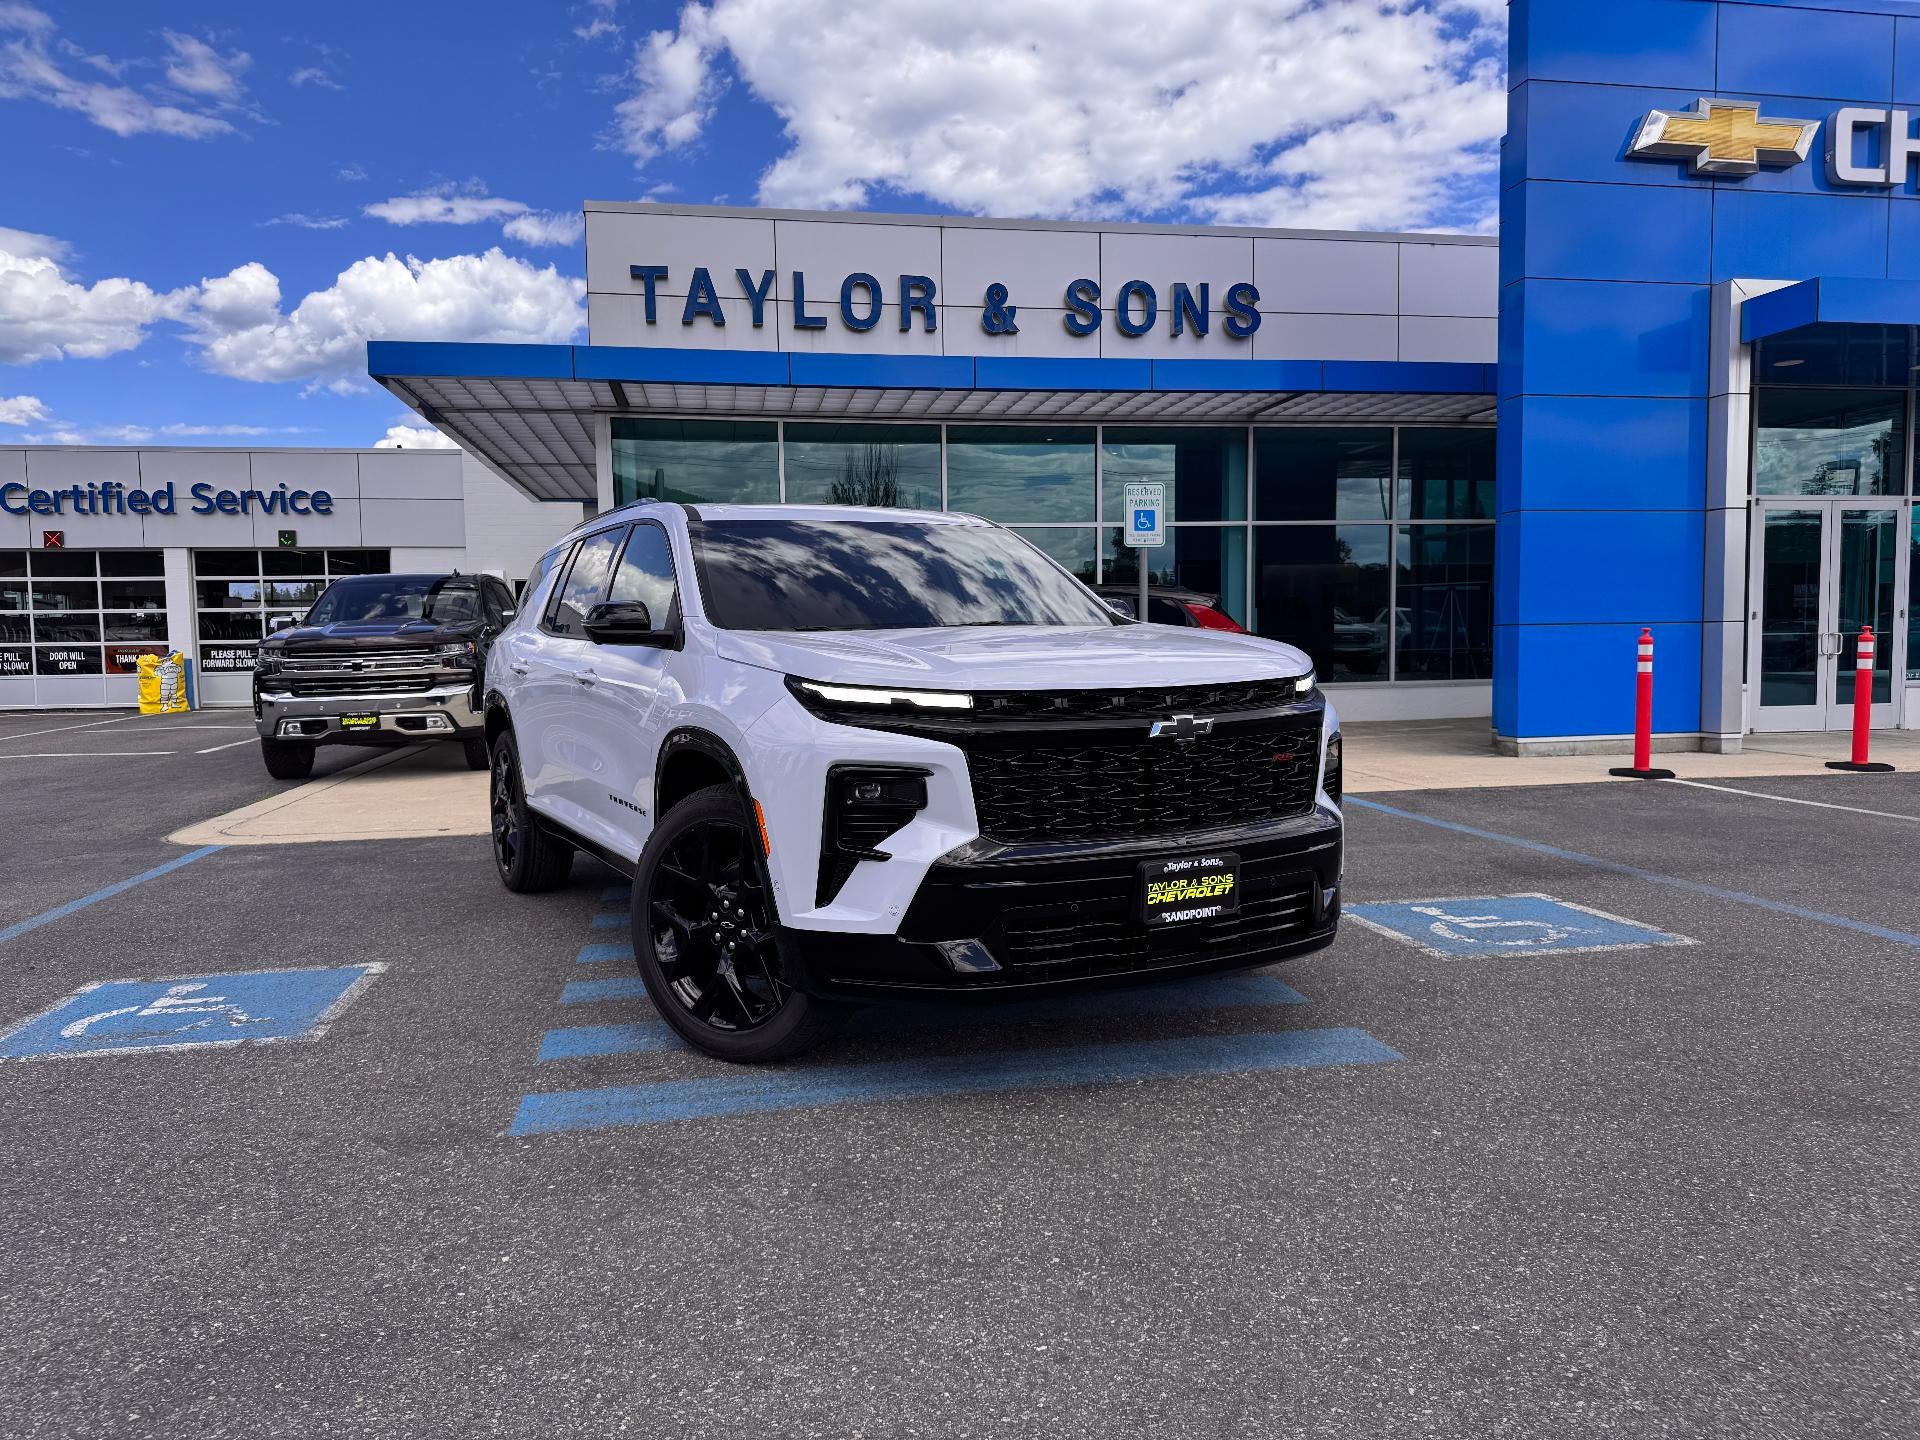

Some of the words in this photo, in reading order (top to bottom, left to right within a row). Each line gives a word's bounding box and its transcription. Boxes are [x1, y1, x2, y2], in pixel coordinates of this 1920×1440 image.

[1833, 107, 1920, 184] CH
[629, 264, 938, 333] TAYLOR
[980, 281, 1020, 336] &
[1064, 277, 1262, 338] SONS
[1127, 488, 1162, 496] RESERVED
[0, 481, 177, 515] Certified
[190, 482, 334, 515] Service
[1129, 499, 1160, 507] PARKING
[49, 652, 68, 660] DOOR
[69, 651, 86, 660] WILL
[211, 650, 235, 658] PLEASE
[236, 650, 252, 658] PULL
[115, 655, 137, 663] THANK
[203, 659, 235, 668] FORWARD
[235, 659, 259, 667] SLOWL
[3, 661, 30, 670] SLOWLY
[59, 661, 77, 669] OPEN
[1167, 860, 1193, 872] Taylor
[1200, 858, 1220, 867] Sons
[1148, 880, 1187, 892] TAYLOR
[1190, 878, 1198, 888] &
[1201, 874, 1233, 884] SONS
[1147, 883, 1234, 905] CHEVROLET
[1165, 906, 1218, 922] SANDPOINT
